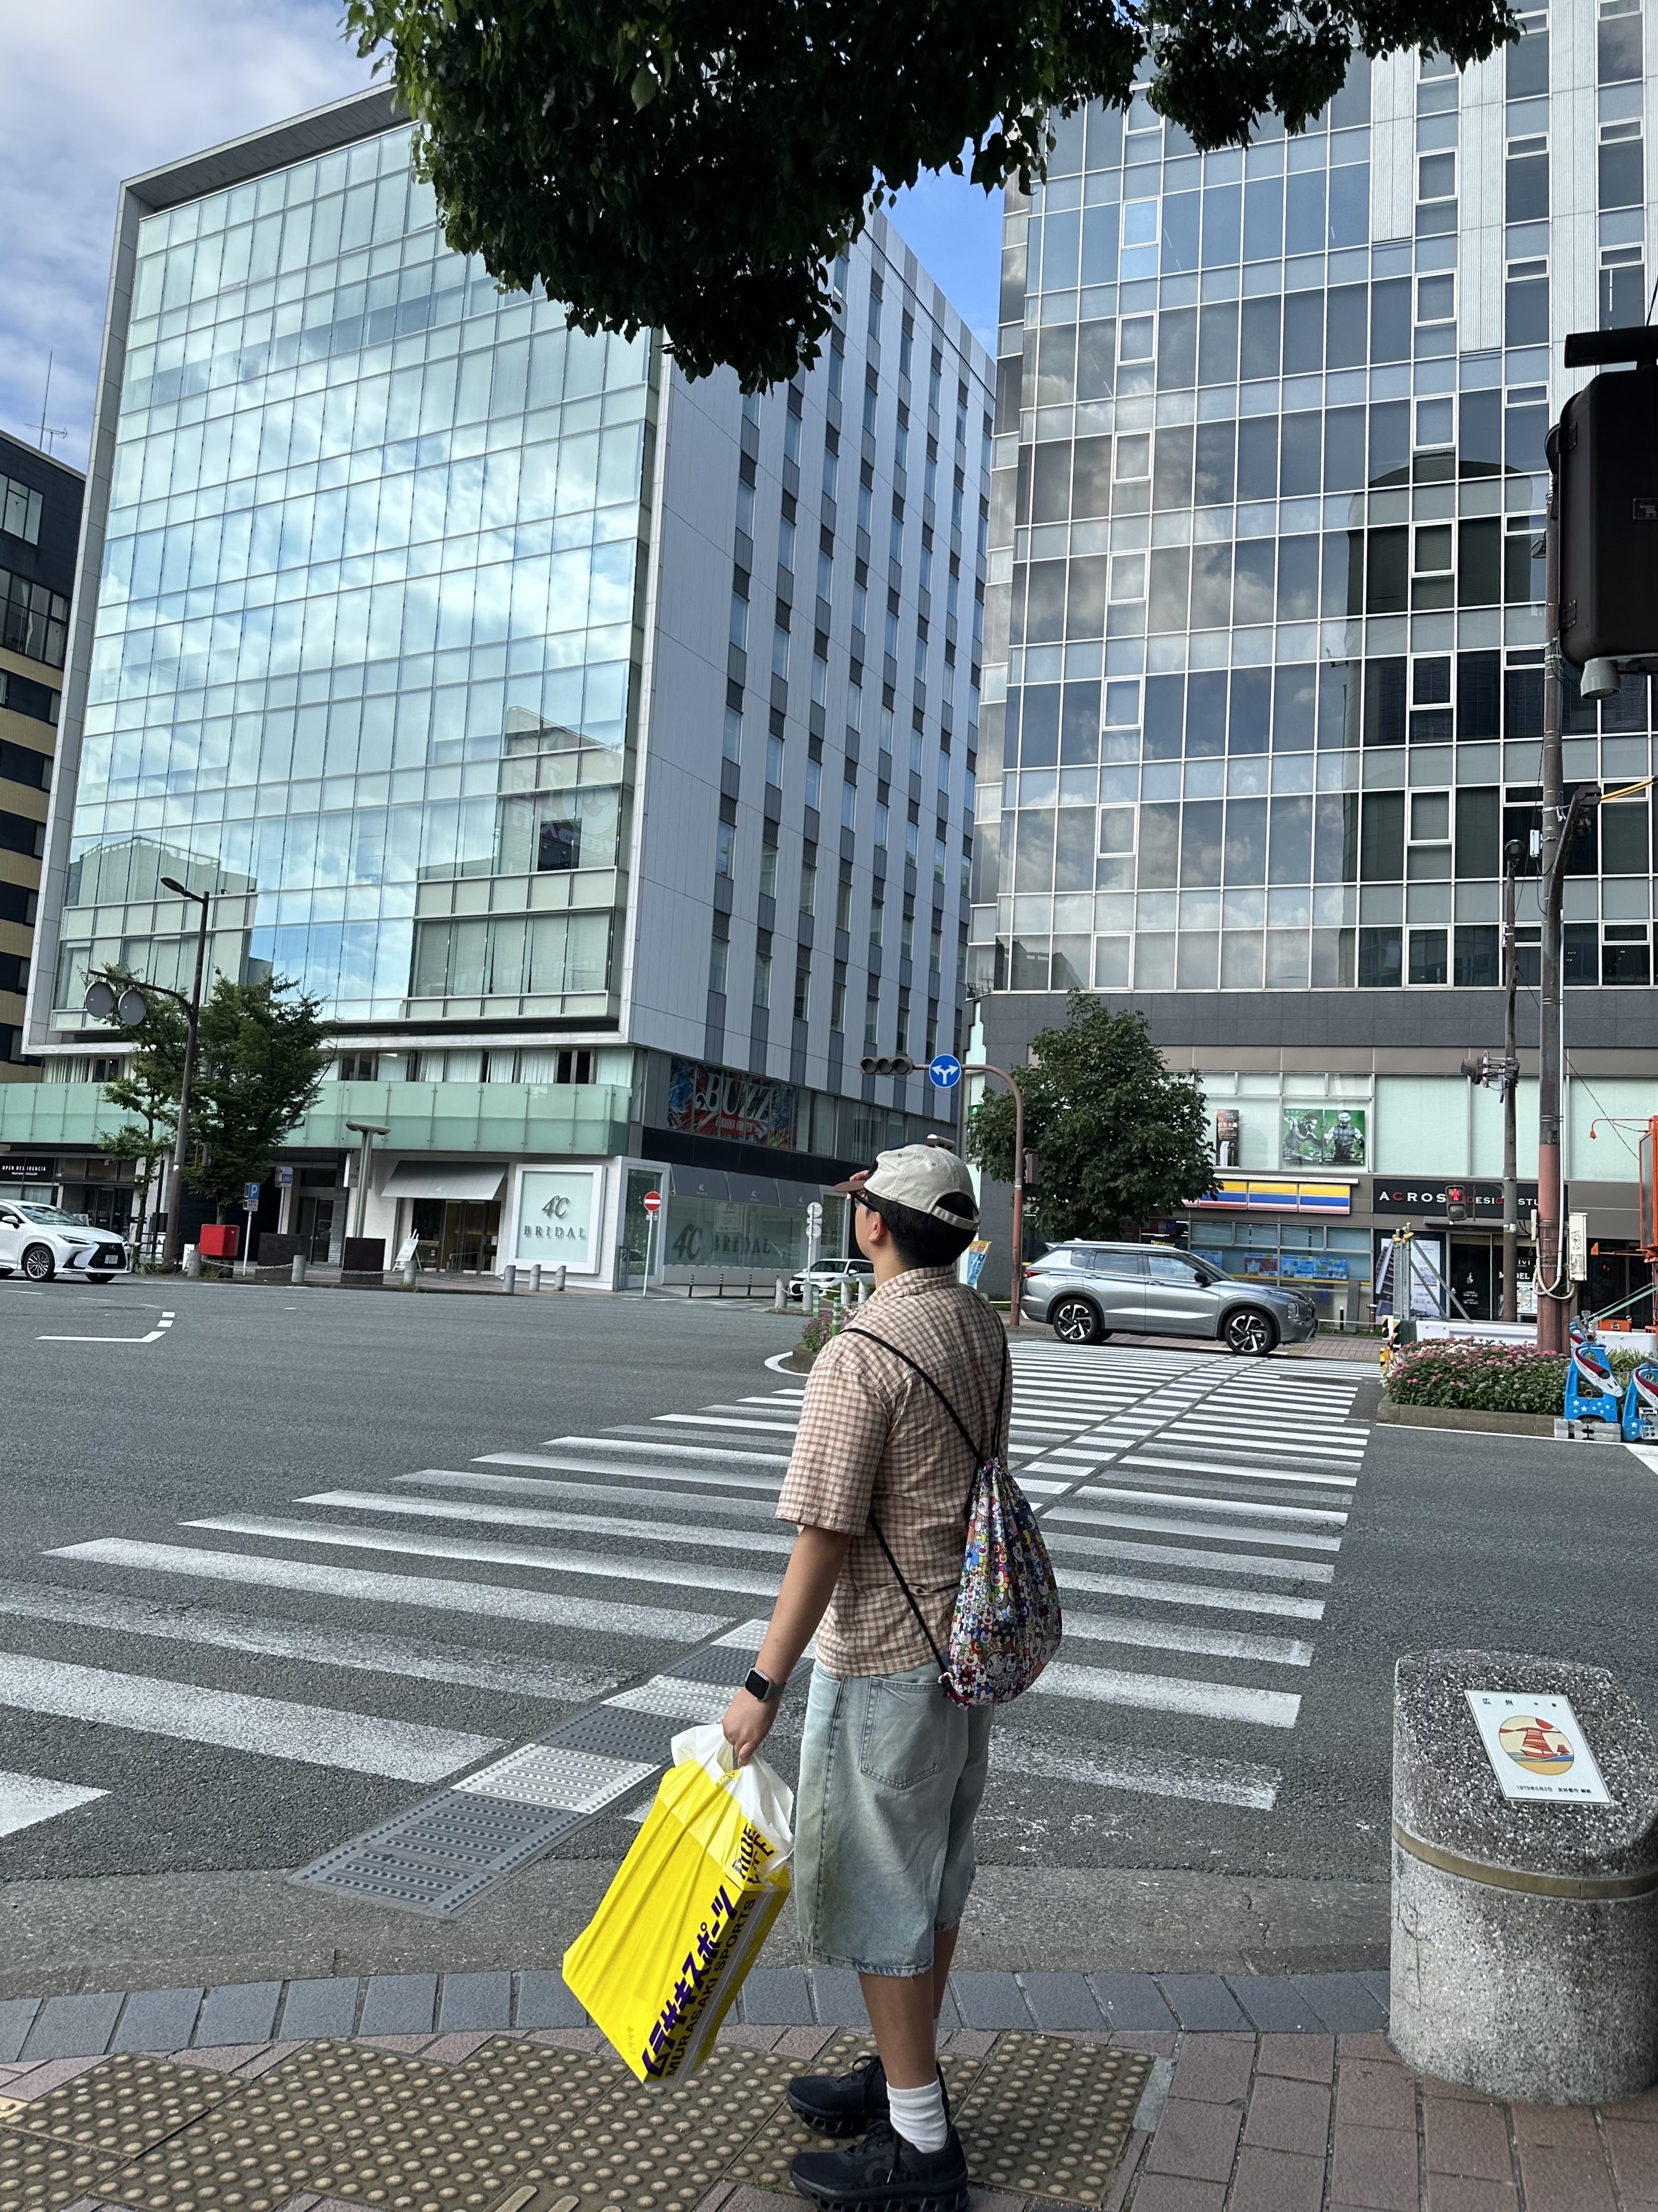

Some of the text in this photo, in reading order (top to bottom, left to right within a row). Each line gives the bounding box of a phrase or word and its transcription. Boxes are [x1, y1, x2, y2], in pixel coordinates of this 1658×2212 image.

[694, 1072, 771, 1124] BUZZ
[251, 1184, 258, 1197] P
[1379, 1191, 1539, 1206] ACROS DESIG STU
[524, 1225, 586, 1239] BRIDAL
[642, 1884, 738, 2077] ムラサキスポーツ
[663, 1899, 756, 2077] MURASAKI SPORTS
